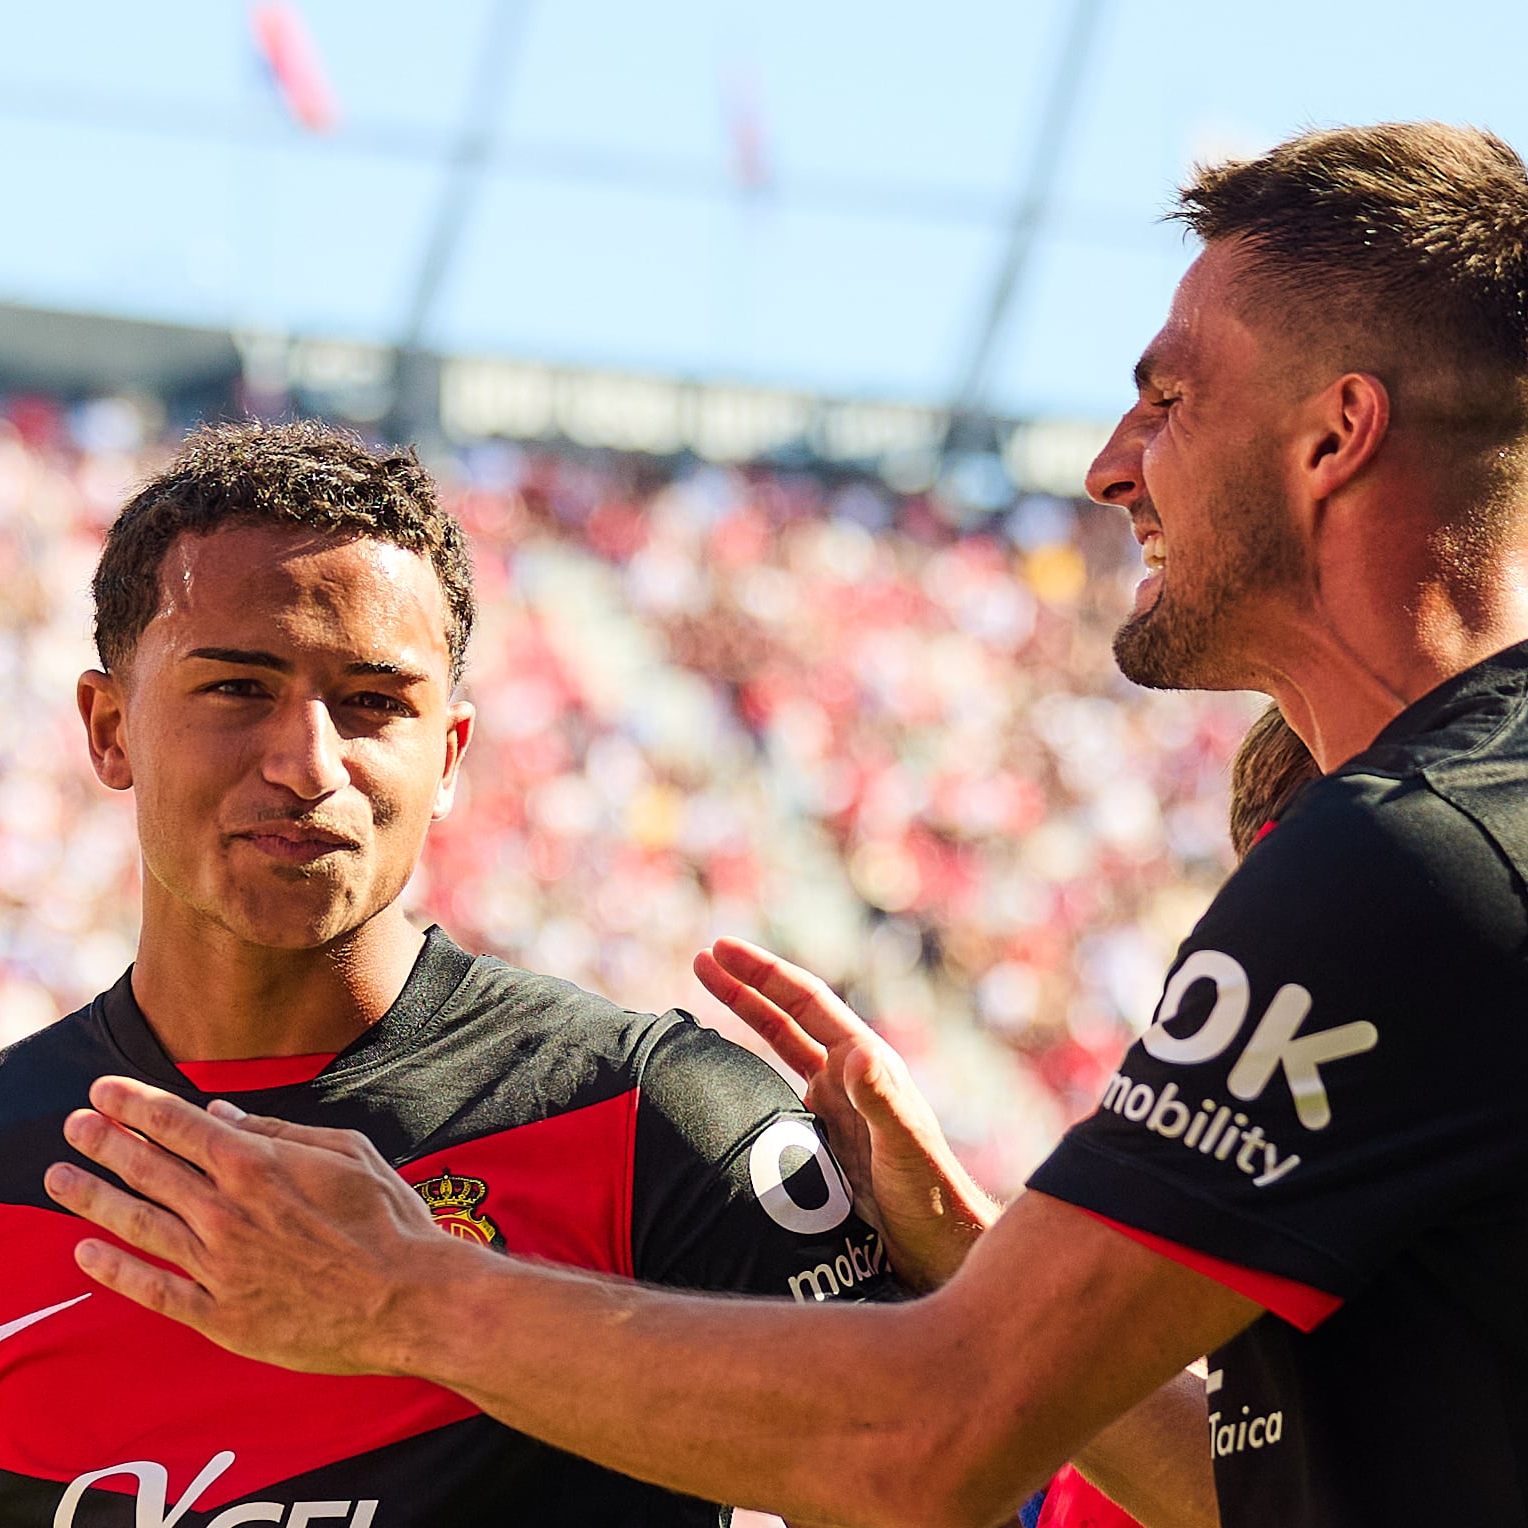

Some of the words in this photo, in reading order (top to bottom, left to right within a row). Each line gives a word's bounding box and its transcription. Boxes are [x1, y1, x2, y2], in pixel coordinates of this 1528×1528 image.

[1141, 949, 1379, 1131] OK
[749, 1120, 852, 1235] O
[1208, 1404, 1284, 1460] Taica
